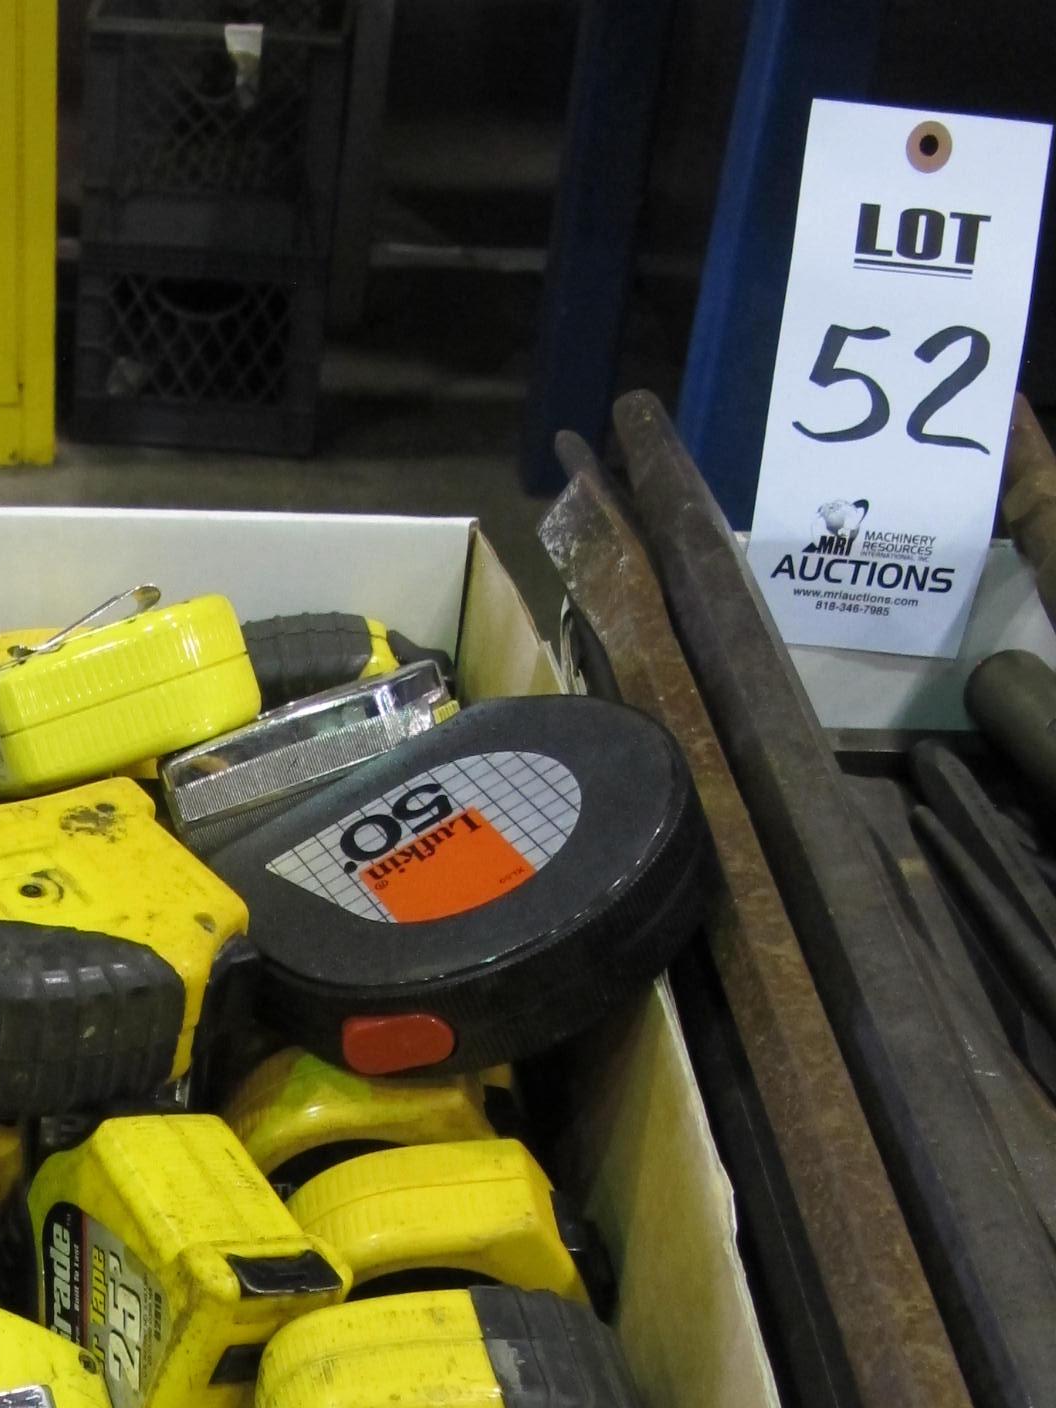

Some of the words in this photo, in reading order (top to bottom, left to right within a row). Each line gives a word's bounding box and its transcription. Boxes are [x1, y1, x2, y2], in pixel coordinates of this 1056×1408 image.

[855, 203, 991, 266] LOT
[791, 324, 991, 455] 52
[817, 534, 854, 557] MRI
[862, 541, 933, 556] RESOURCES
[864, 531, 936, 546] MACHINERY
[770, 554, 955, 593] AUCTIONS
[793, 587, 919, 607] www.mriauctions.com
[815, 600, 890, 616] 818-346-7985
[367, 813, 481, 880] Lufkin
[90, 1245, 106, 1326] Tape
